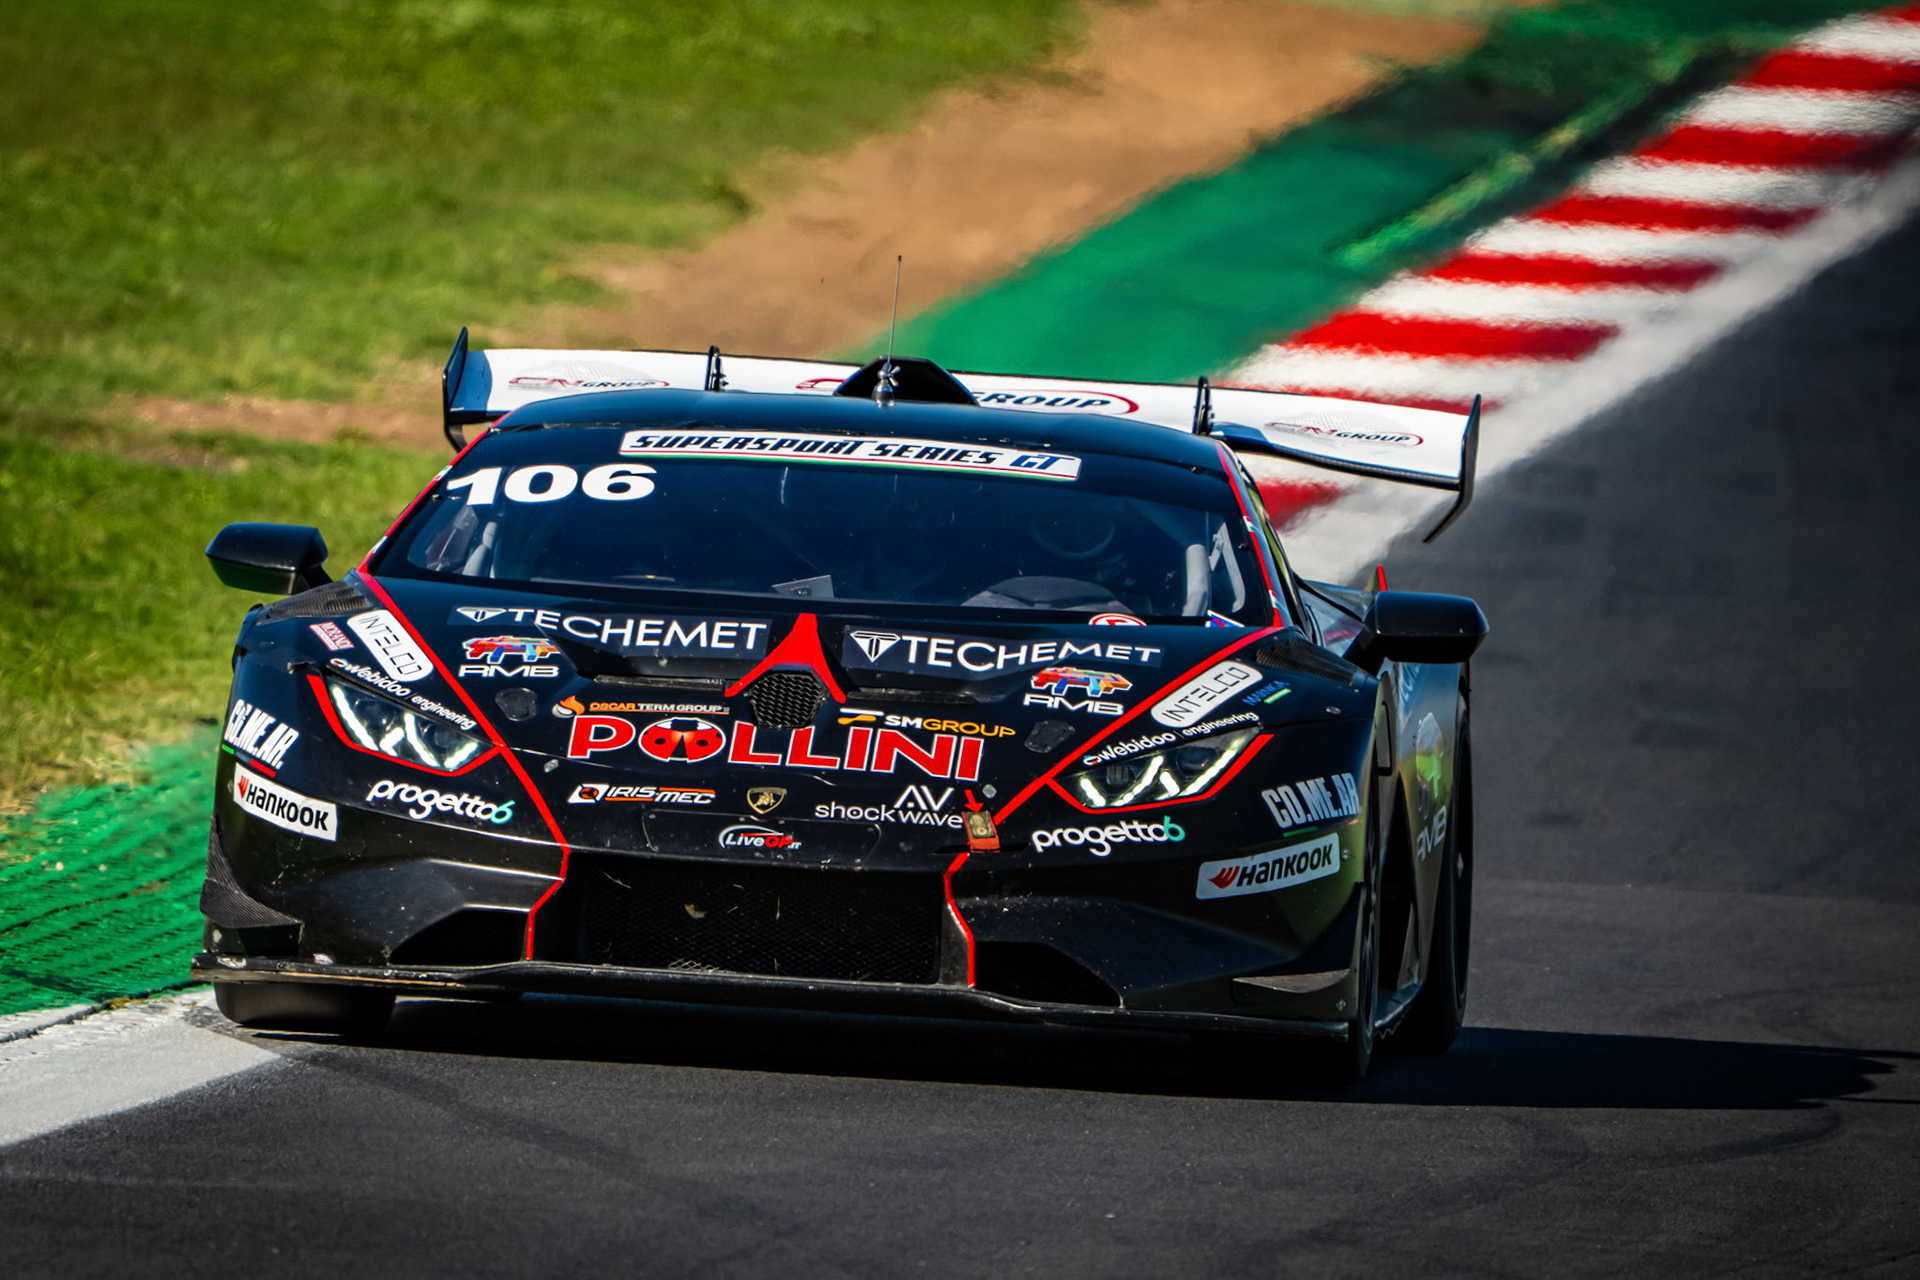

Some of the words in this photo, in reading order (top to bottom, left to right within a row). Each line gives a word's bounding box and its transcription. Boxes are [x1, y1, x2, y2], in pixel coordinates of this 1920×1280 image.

[582, 381, 657, 389] GROUP
[630, 435, 878, 456] SUPERSPORT
[868, 443, 1003, 464] SERIES
[1009, 454, 1075, 470] GT
[1335, 431, 1411, 443] GROUP
[446, 464, 657, 506] 106
[358, 615, 423, 676] INTELCO
[508, 608, 767, 650] TECHEMET
[458, 664, 560, 678] RMB
[902, 635, 1161, 672] TECHEMET
[411, 693, 478, 731] engineering
[590, 702, 636, 711] OSCAR
[1023, 693, 1125, 717] RMB
[1161, 666, 1250, 722] INTELCO
[1182, 711, 1260, 737] engineering
[567, 714, 985, 782] POLLINI
[365, 779, 516, 825] progetto6
[1031, 815, 1186, 857] progetto6
